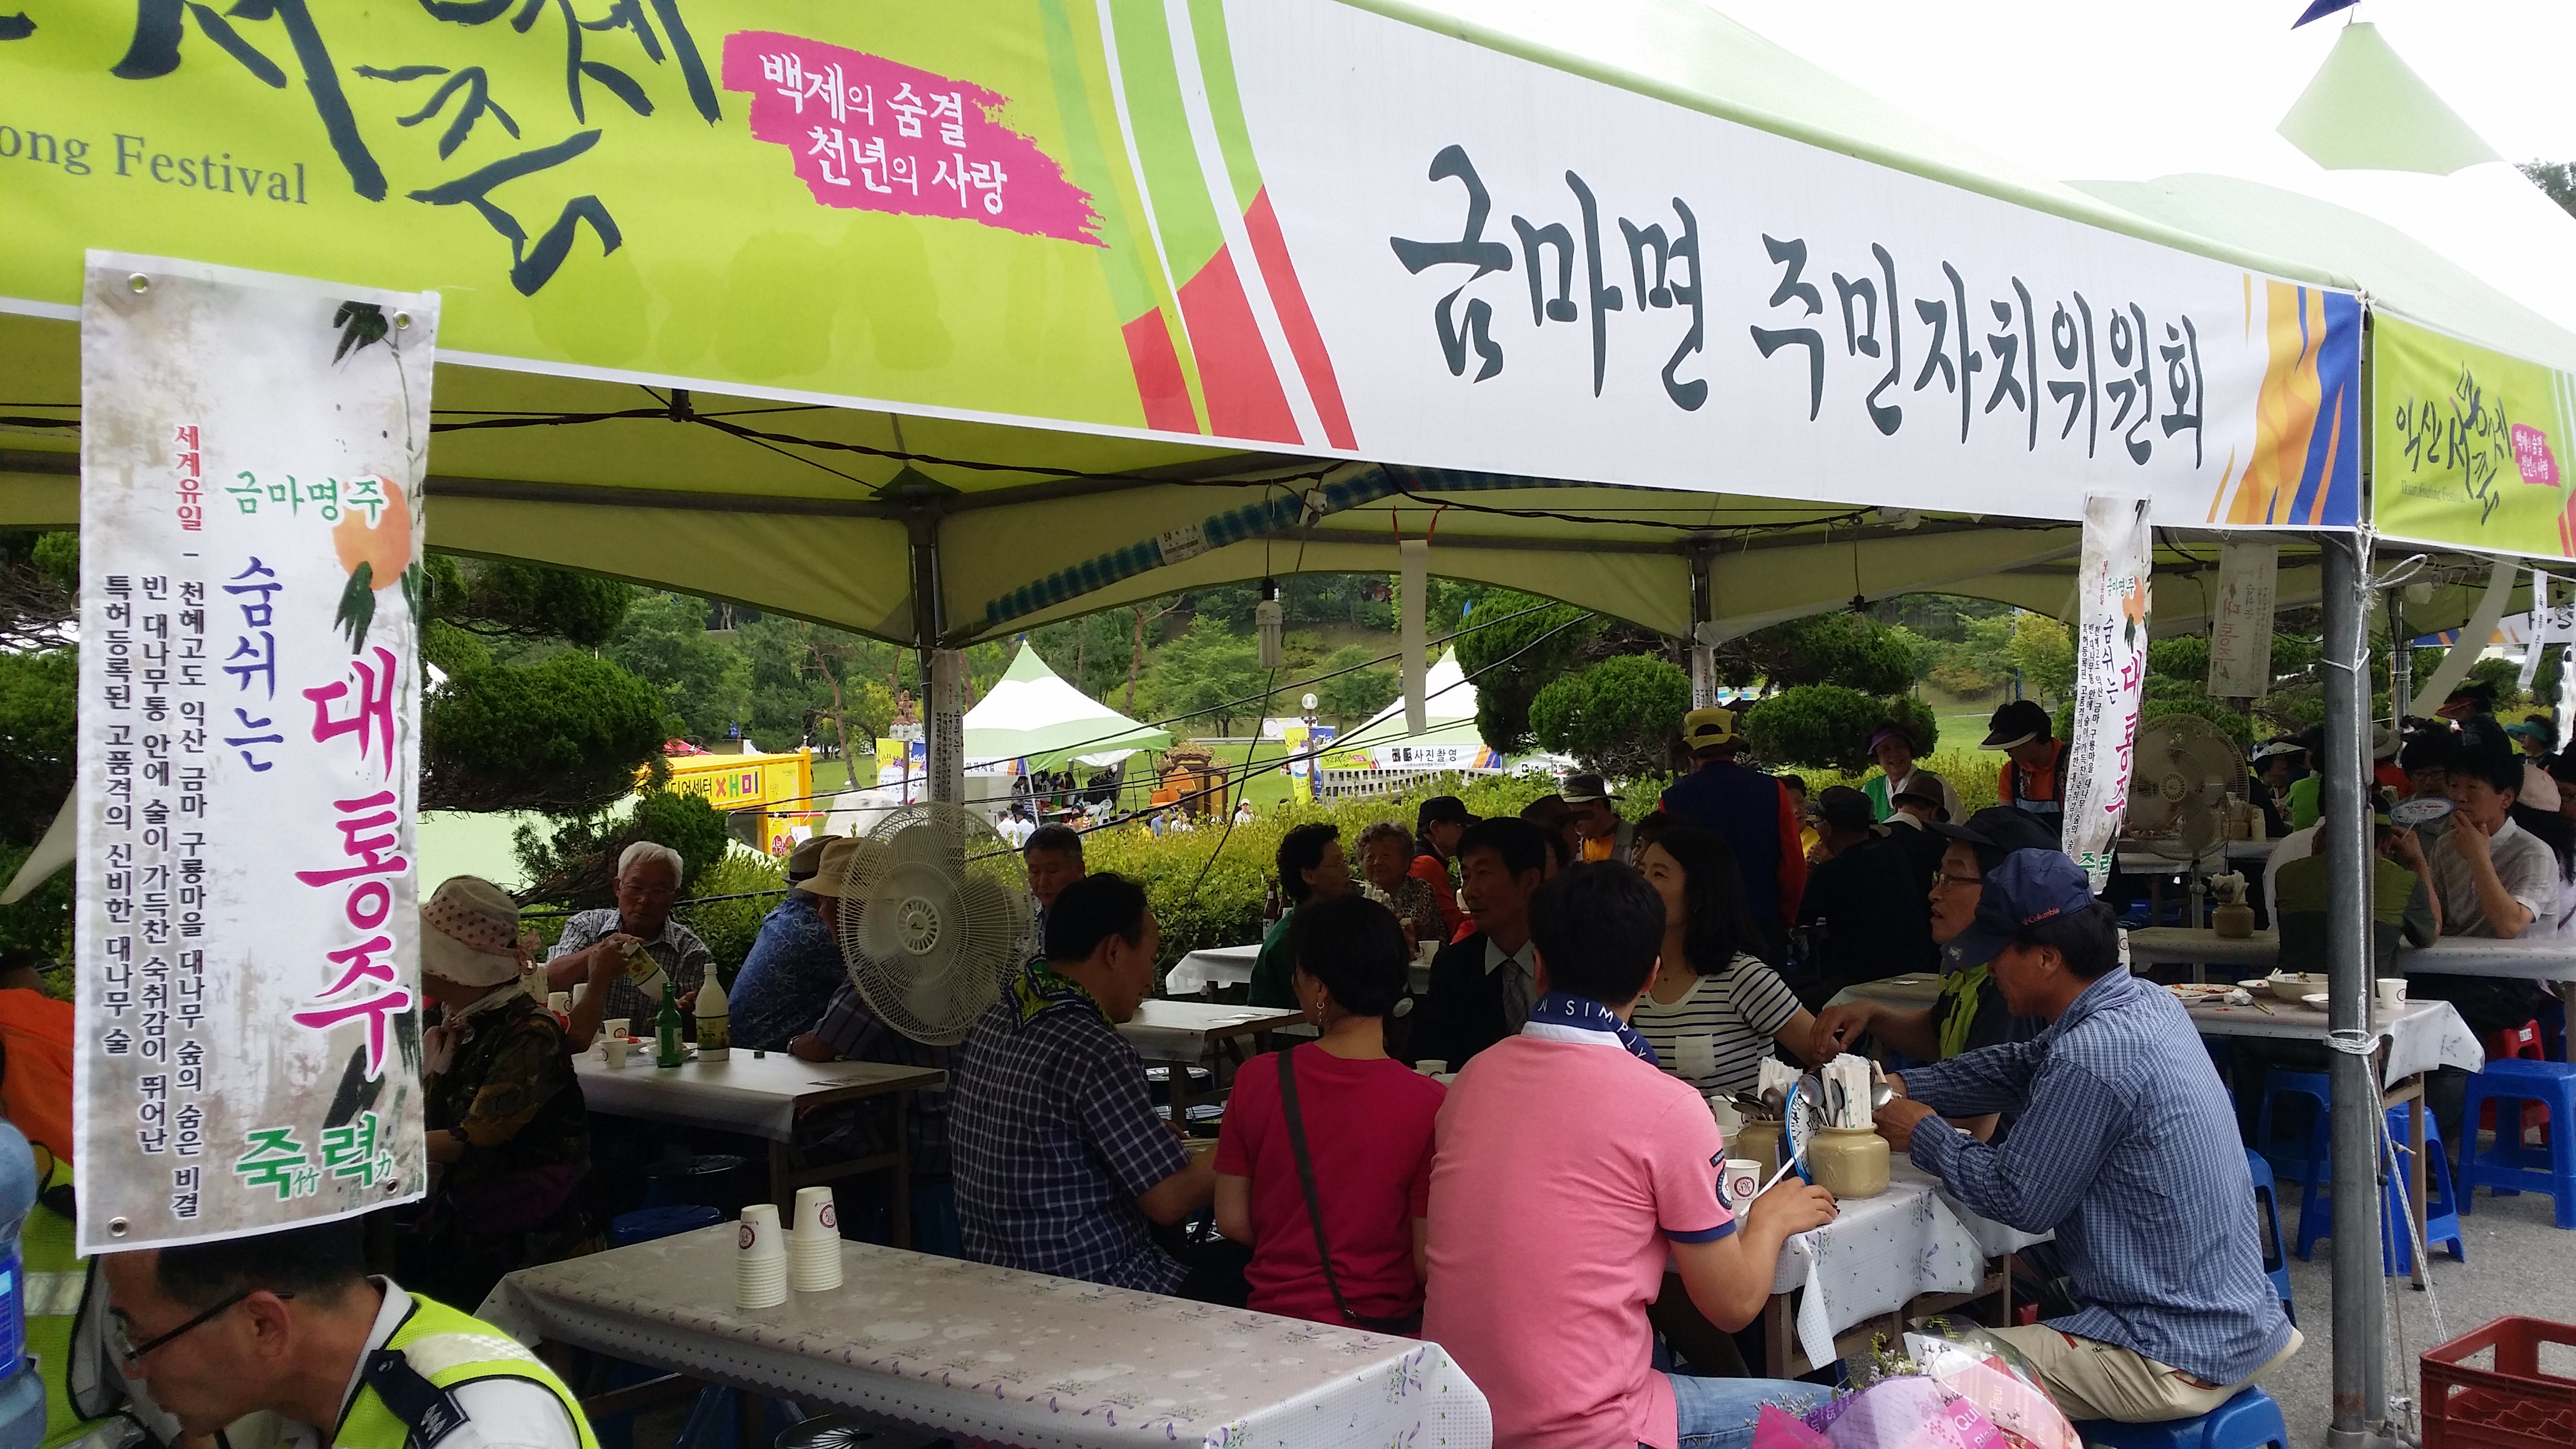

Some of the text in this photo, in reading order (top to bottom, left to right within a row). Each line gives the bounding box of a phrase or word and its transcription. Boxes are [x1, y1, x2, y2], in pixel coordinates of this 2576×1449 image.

[759, 51, 967, 149] 백제의 숨결
[113, 132, 308, 205] Festival
[806, 124, 1008, 215] 천년의 사랑
[1390, 144, 2205, 471] 금마면 주민자치위원회
[2396, 393, 2443, 473] 익산
[2532, 434, 2543, 456] 숨결
[2538, 458, 2548, 480] 사랑
[174, 425, 203, 532] 세계유일
[224, 470, 385, 522] 금마명주
[2106, 576, 2135, 598] 금마명주
[178, 581, 207, 687] 천혜고도
[221, 555, 285, 773] 숨쉬는
[2101, 614, 2119, 706] 숨쉬는
[178, 700, 207, 754] 익산
[2091, 702, 2102, 725] 금마
[2104, 649, 2144, 837] 대통주
[1414, 748, 1458, 763] 사진촬영
[102, 575, 134, 1055] 특허등록된 고품격의 신비한 대나무 술
[178, 766, 208, 819] 금마
[138, 575, 171, 1155] 빈 대나무통 안에 술이 가득찬 숙취감이 뛰어난
[177, 832, 207, 938] 구룡마을
[291, 646, 409, 1078] 대통주
[2028, 907, 2060, 924] Columbia
[175, 949, 205, 1030] 대나무
[1564, 1000, 1647, 1058] SIMPLY
[175, 1039, 205, 1093] 숲의
[174, 1104, 203, 1157] 숨은
[172, 1166, 200, 1219] 비결
[1988, 1383, 2003, 1411] Fleur
